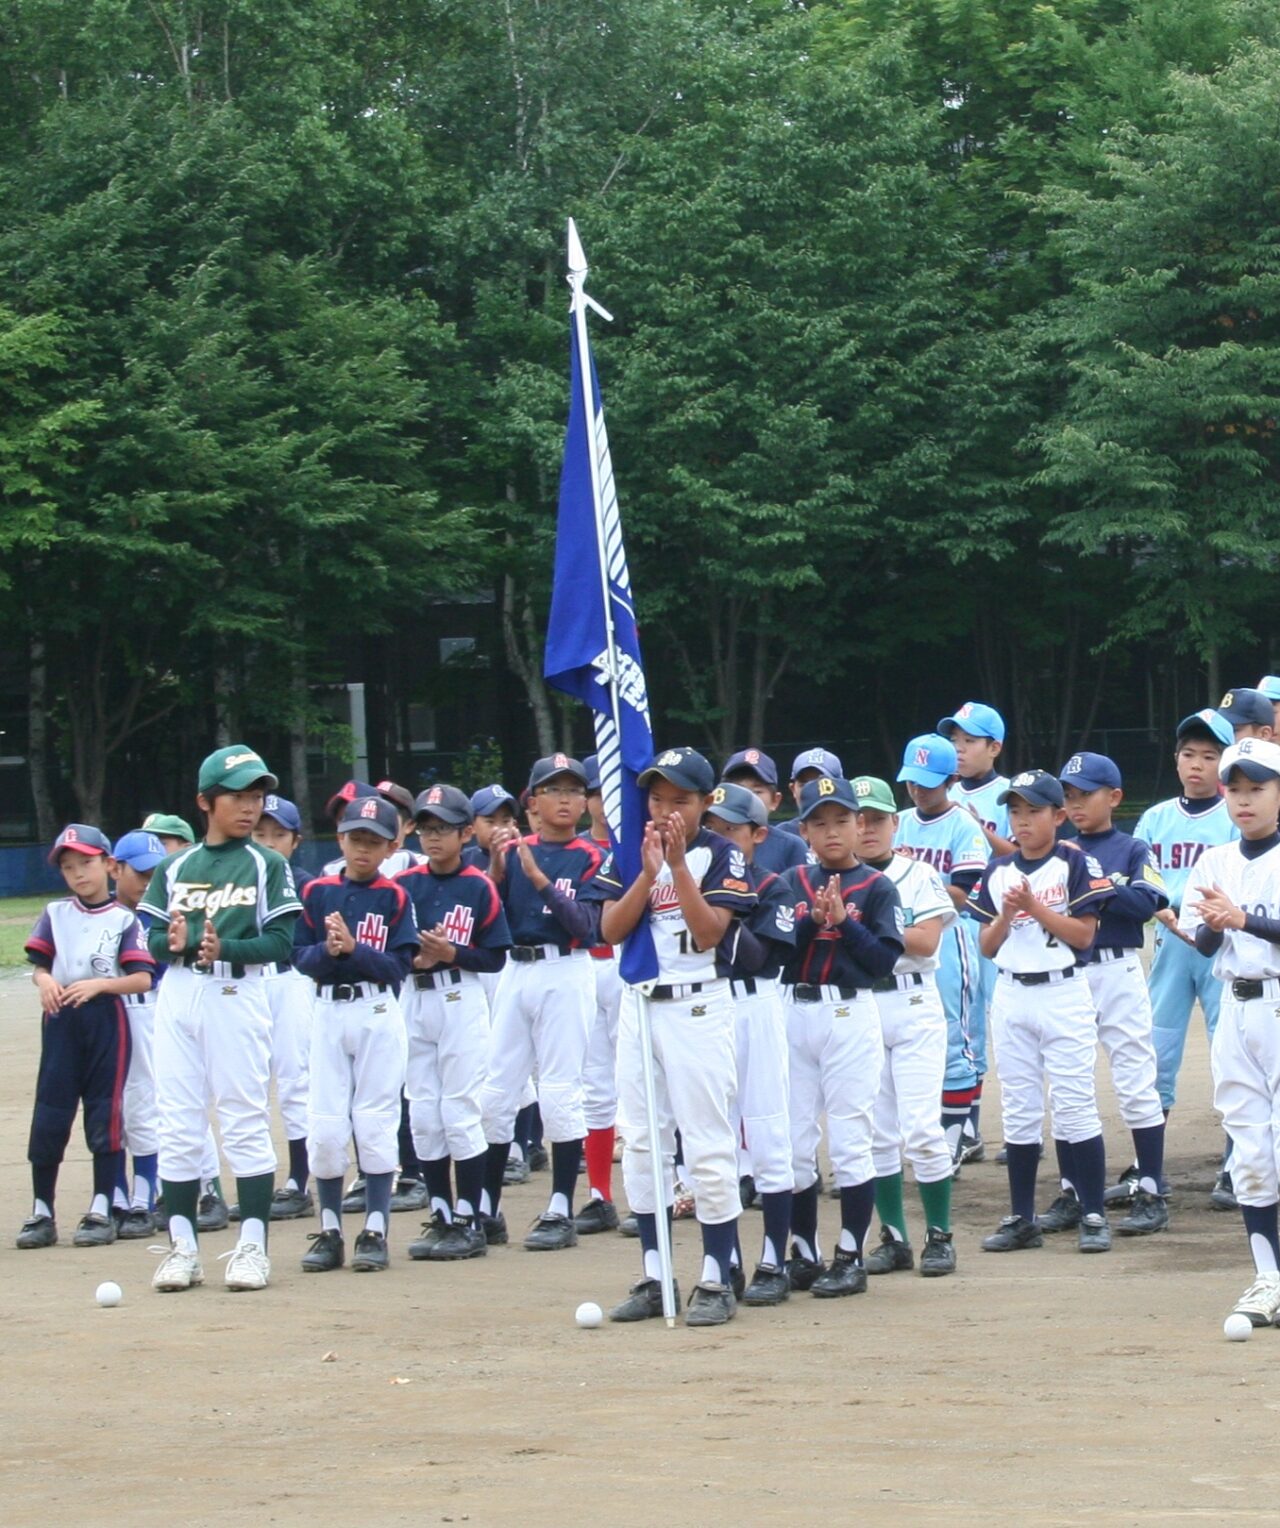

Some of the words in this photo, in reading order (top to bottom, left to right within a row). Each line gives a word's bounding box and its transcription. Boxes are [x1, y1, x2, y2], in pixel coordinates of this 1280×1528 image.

[914, 748, 929, 767] N
[819, 778, 835, 796] B
[168, 883, 257, 919] Eagles
